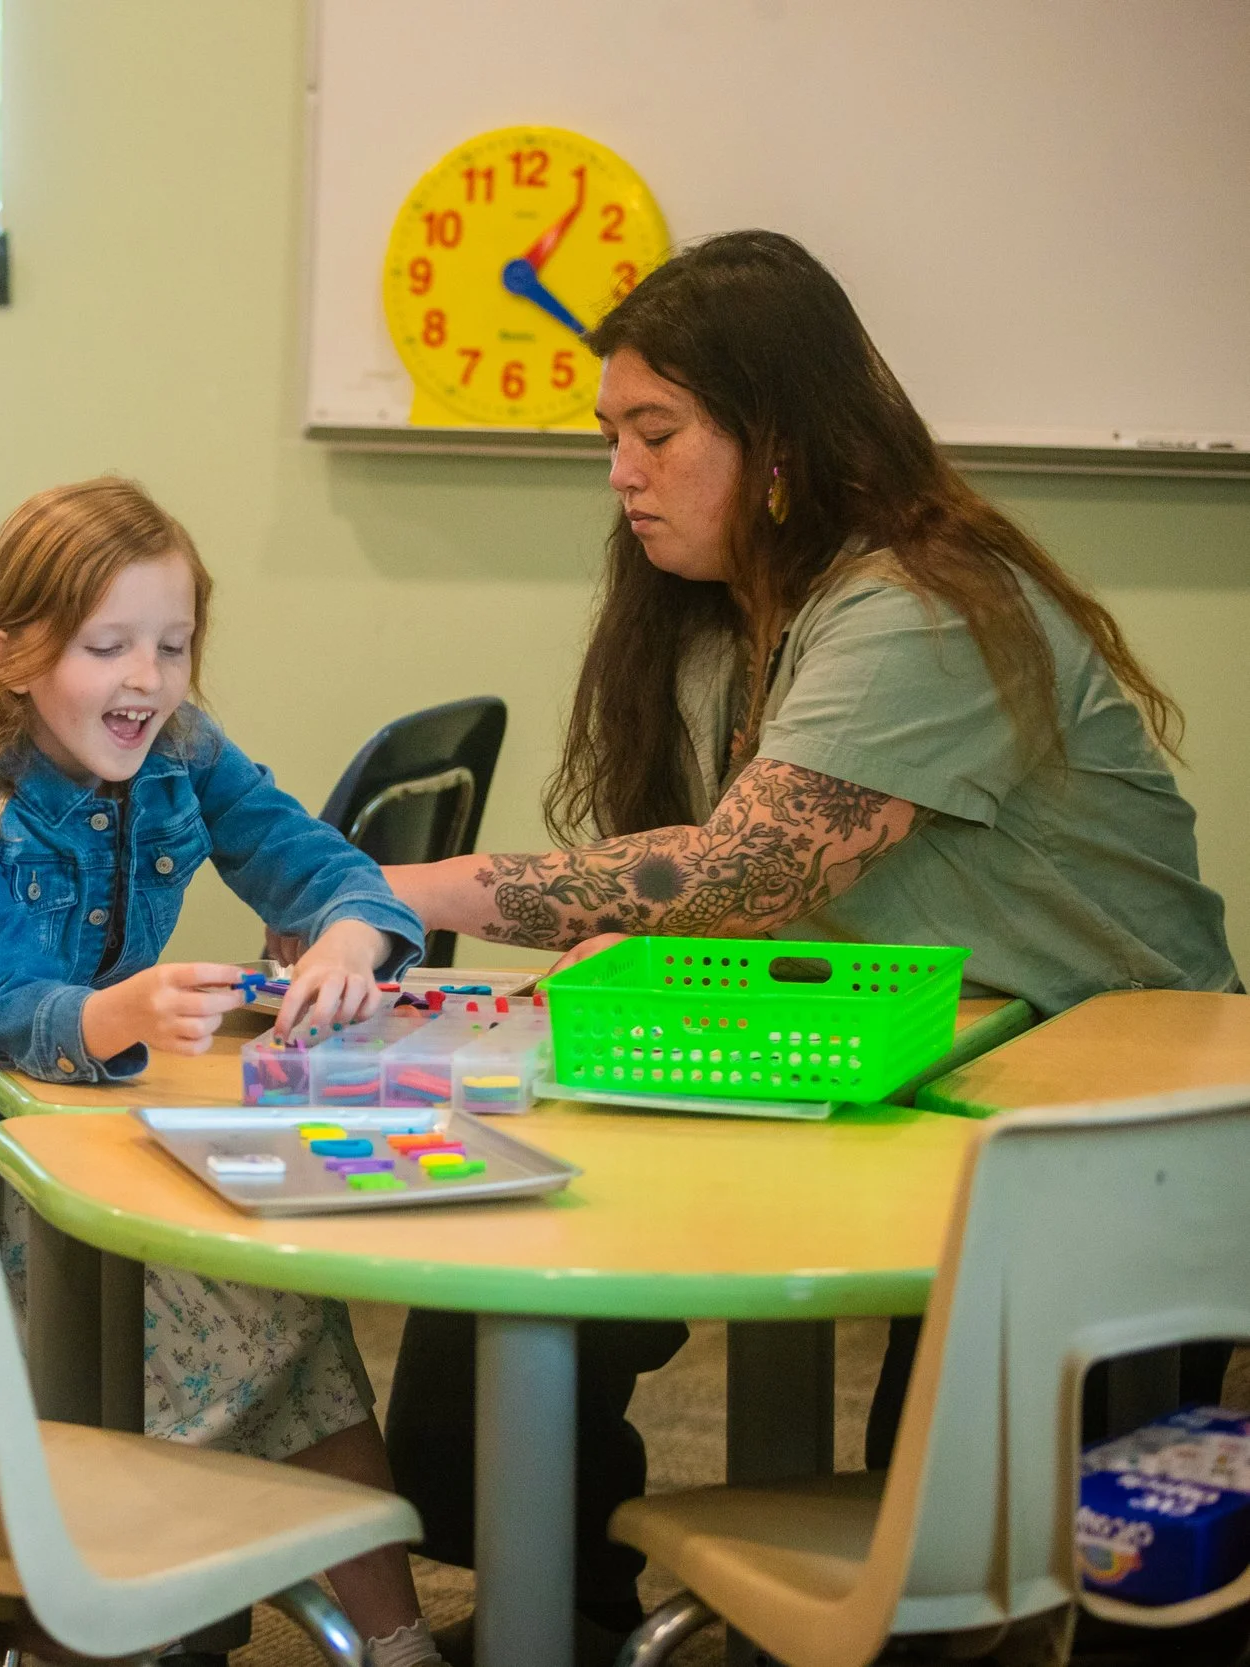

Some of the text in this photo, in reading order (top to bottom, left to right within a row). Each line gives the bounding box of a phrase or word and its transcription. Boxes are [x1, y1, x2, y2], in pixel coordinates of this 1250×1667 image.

[461, 166, 495, 204] 11
[509, 149, 550, 188] 12
[571, 164, 587, 203] 1
[422, 209, 463, 249] 10
[599, 203, 625, 243] 2
[408, 256, 434, 296] 9
[613, 261, 637, 301] 3
[422, 308, 447, 348] 8
[458, 348, 483, 386] 7
[500, 360, 527, 400] 6
[551, 350, 576, 390] 5
